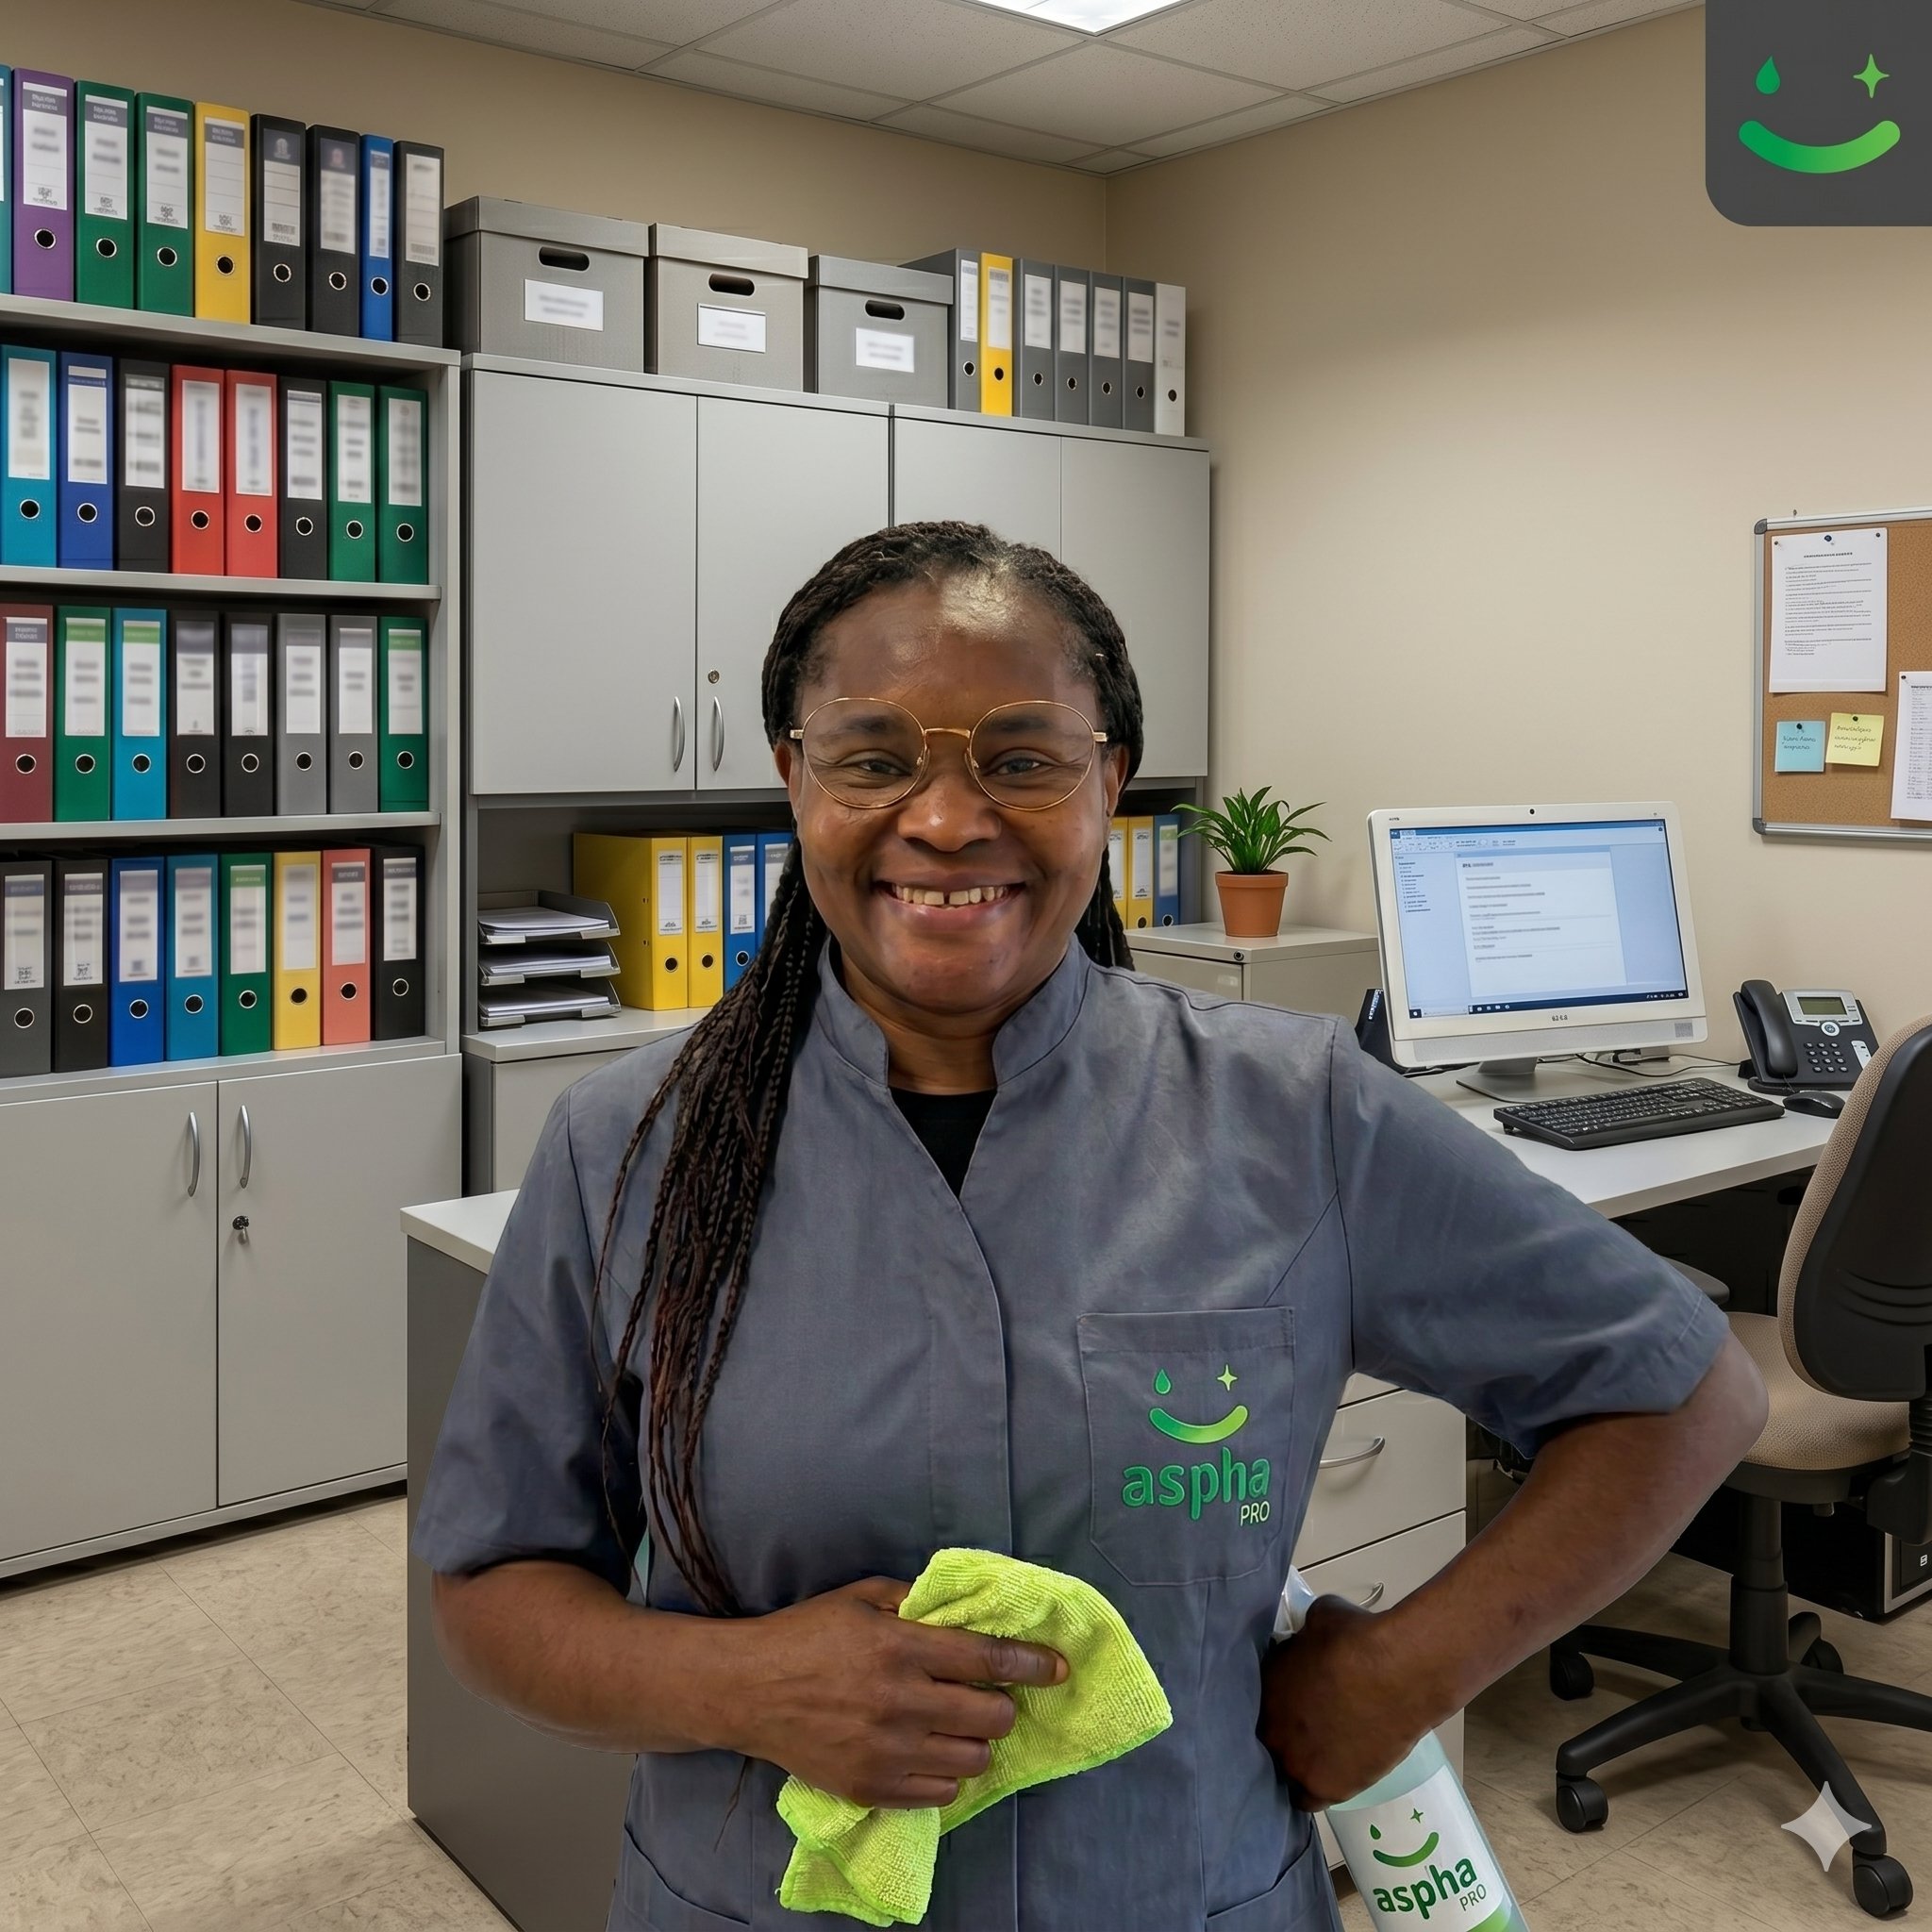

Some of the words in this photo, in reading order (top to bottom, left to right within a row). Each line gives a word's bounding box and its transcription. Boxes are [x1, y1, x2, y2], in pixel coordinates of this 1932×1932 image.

[1123, 1447, 1270, 1520] aspha
[1239, 1500, 1271, 1527] PRO
[1373, 1857, 1478, 1921] aspha
[1458, 1883, 1488, 1912] PRO
